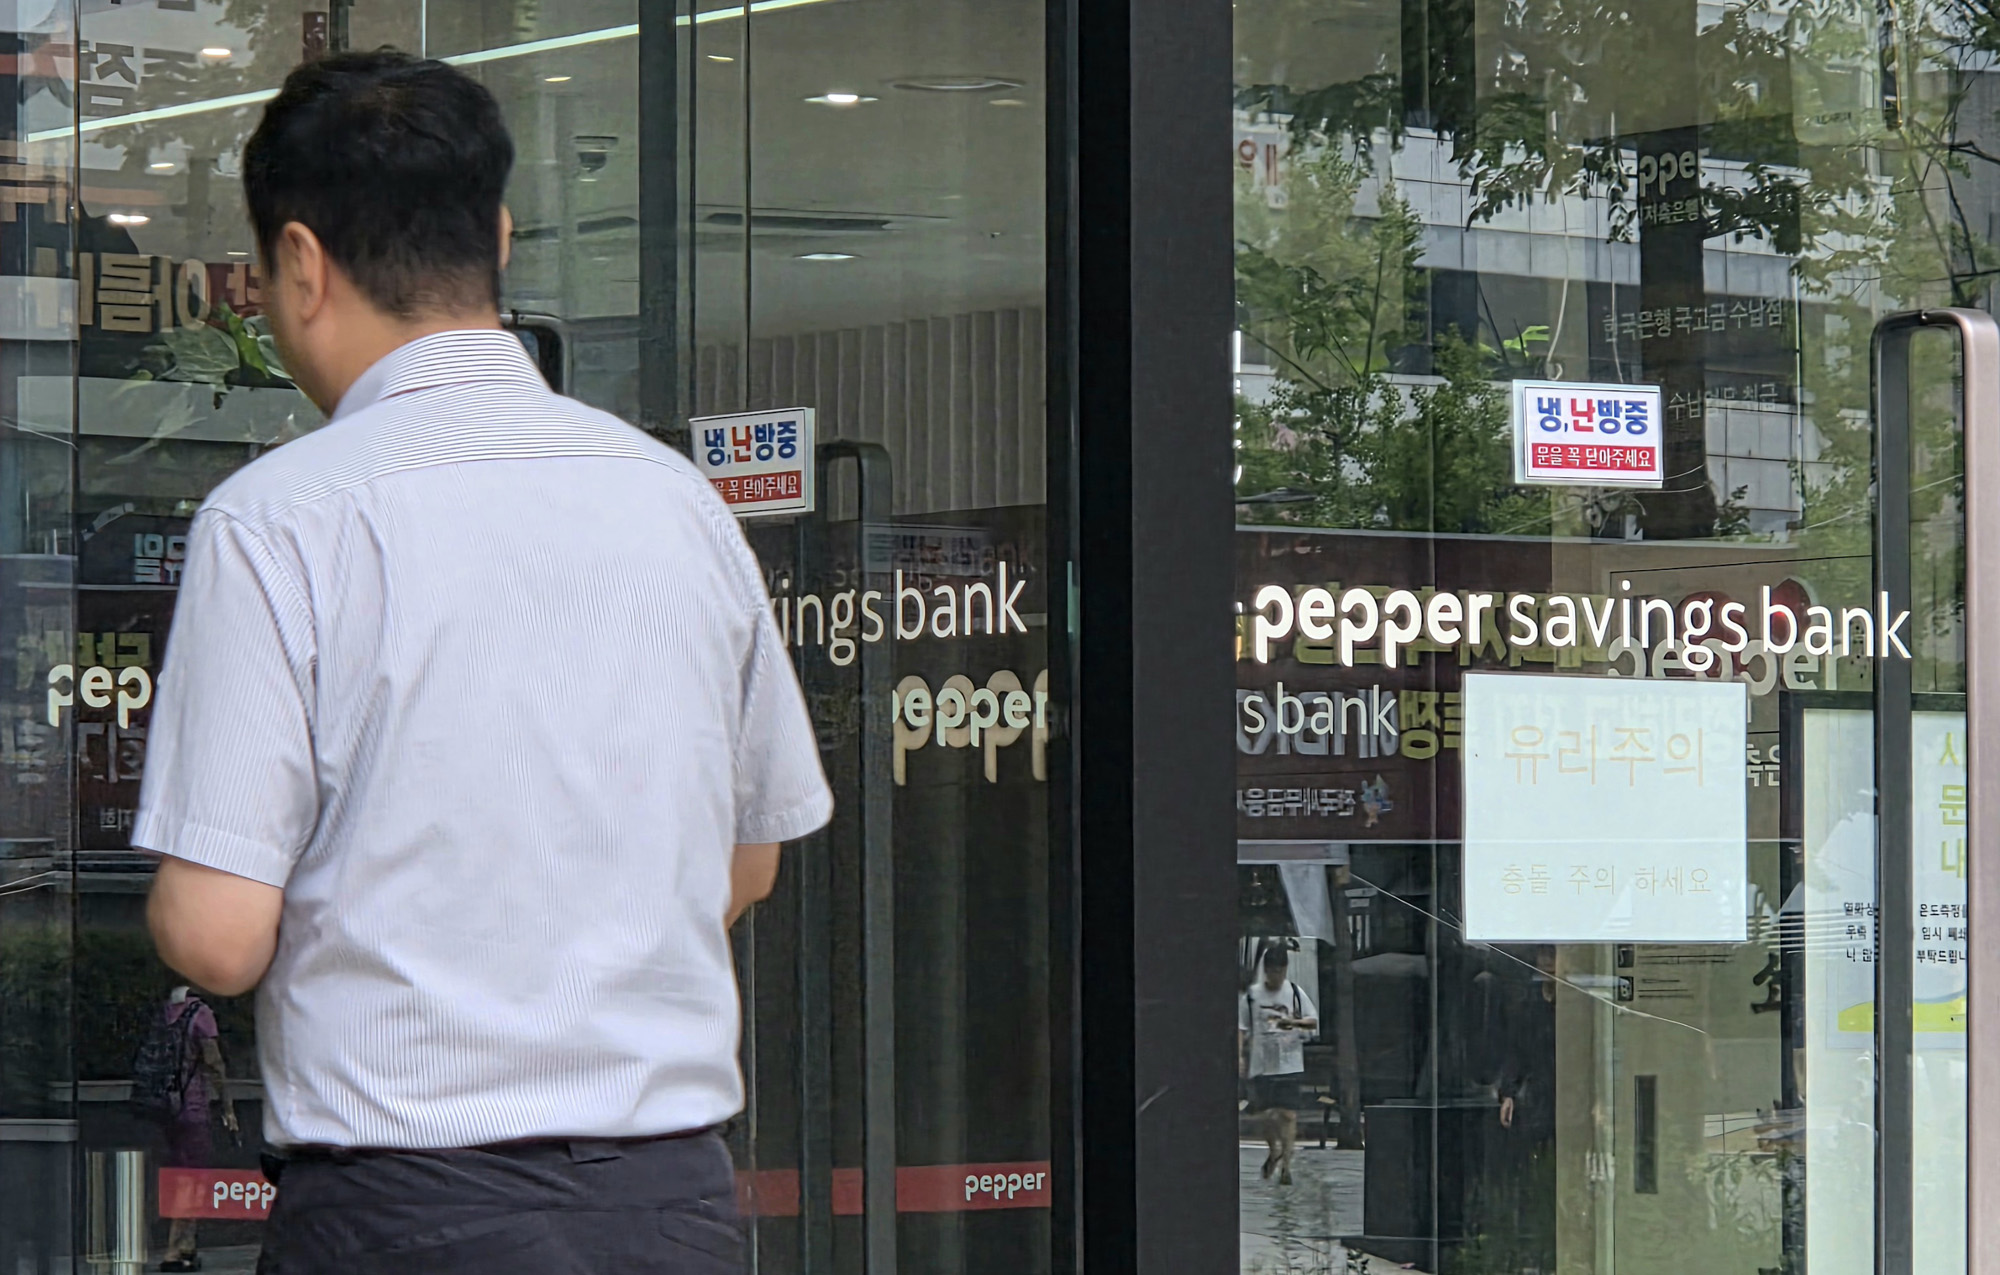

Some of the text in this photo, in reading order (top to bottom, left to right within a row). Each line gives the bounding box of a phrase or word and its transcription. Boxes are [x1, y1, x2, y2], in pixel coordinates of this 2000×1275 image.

[1537, 396, 1649, 435] 냉,난방중
[704, 420, 798, 467] 냉,난방중
[1537, 446, 1651, 468] 문을 꼭 닫아주세요
[770, 577, 886, 667] ings
[896, 560, 1028, 641] bank
[1254, 583, 1494, 669] pepper
[1508, 578, 1749, 672] savings
[1761, 584, 1913, 660] bank
[47, 663, 164, 730] pep
[1276, 681, 1399, 736] bank
[1504, 724, 1704, 787] 유리주의
[1501, 864, 1712, 897] 충돌 주의 하세요
[964, 1171, 1047, 1201] pepper
